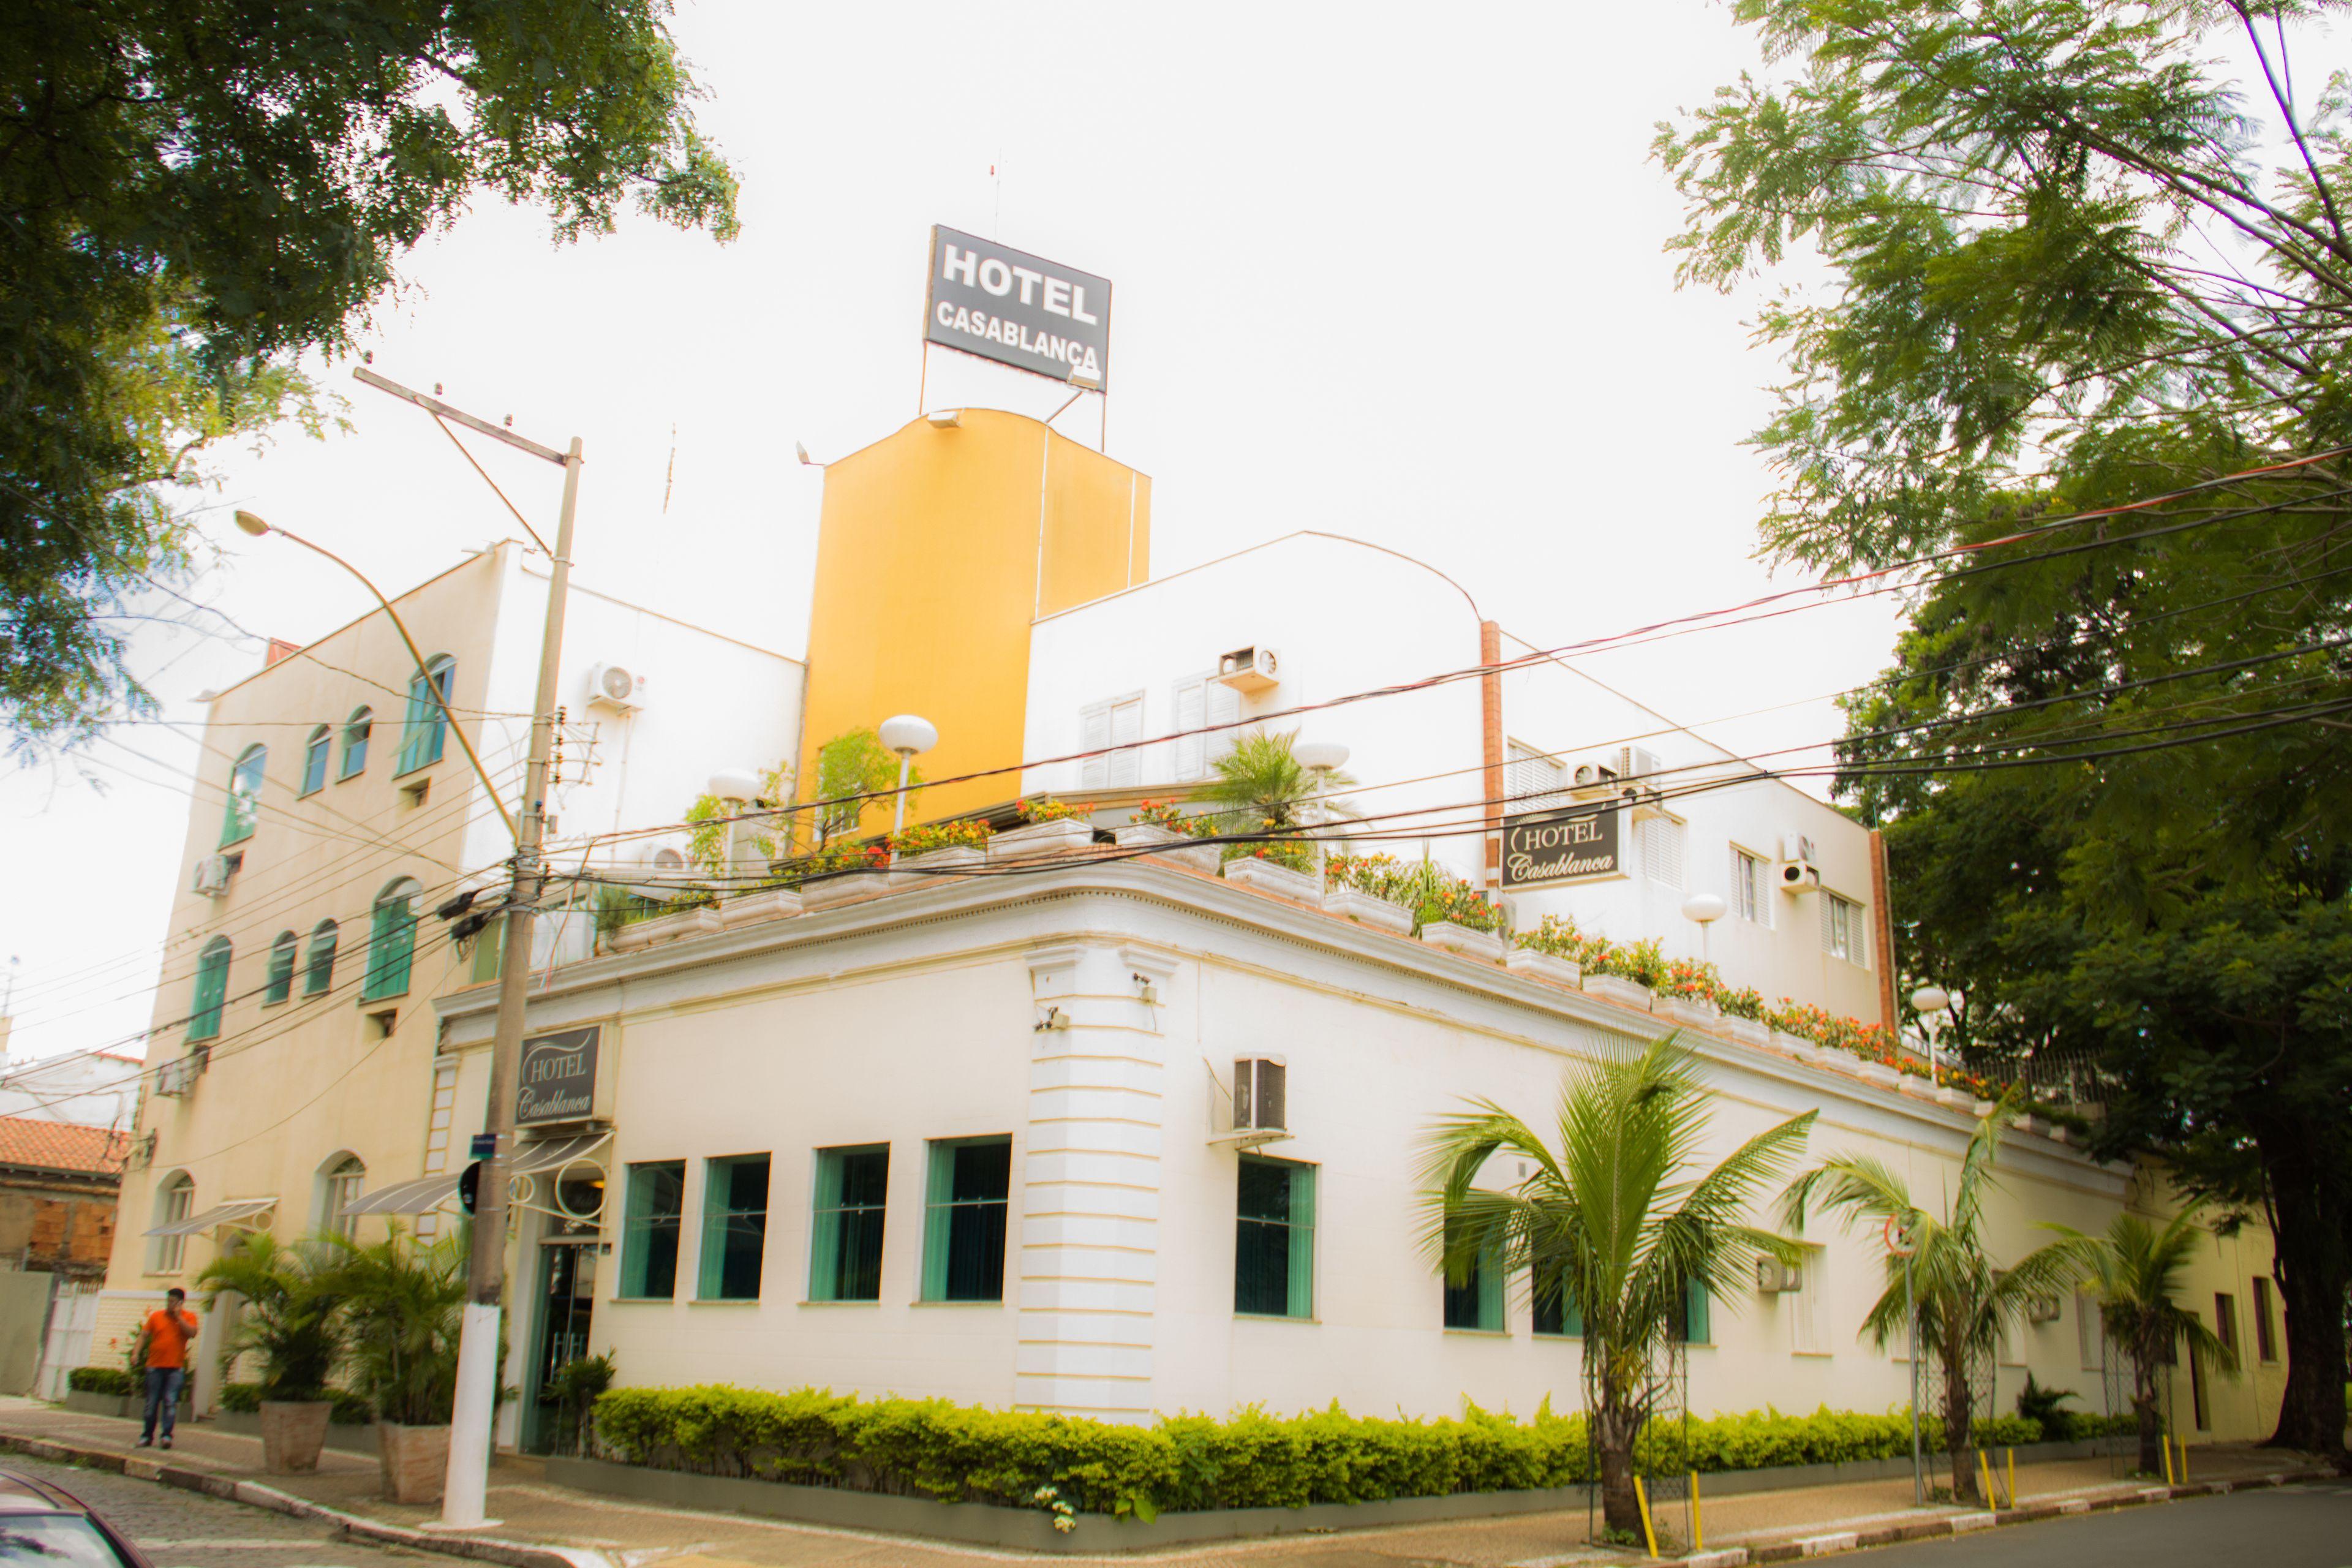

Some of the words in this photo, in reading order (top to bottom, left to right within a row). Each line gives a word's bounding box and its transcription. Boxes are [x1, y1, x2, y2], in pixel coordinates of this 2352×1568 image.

[943, 243, 1098, 326] HOTEL
[937, 301, 1101, 371] CASABLANCA
[1524, 821, 1604, 851] HOTEL
[1507, 851, 1614, 882] Casablanca
[530, 1053, 587, 1084] HOTEL
[519, 1085, 590, 1120] Casablanca
